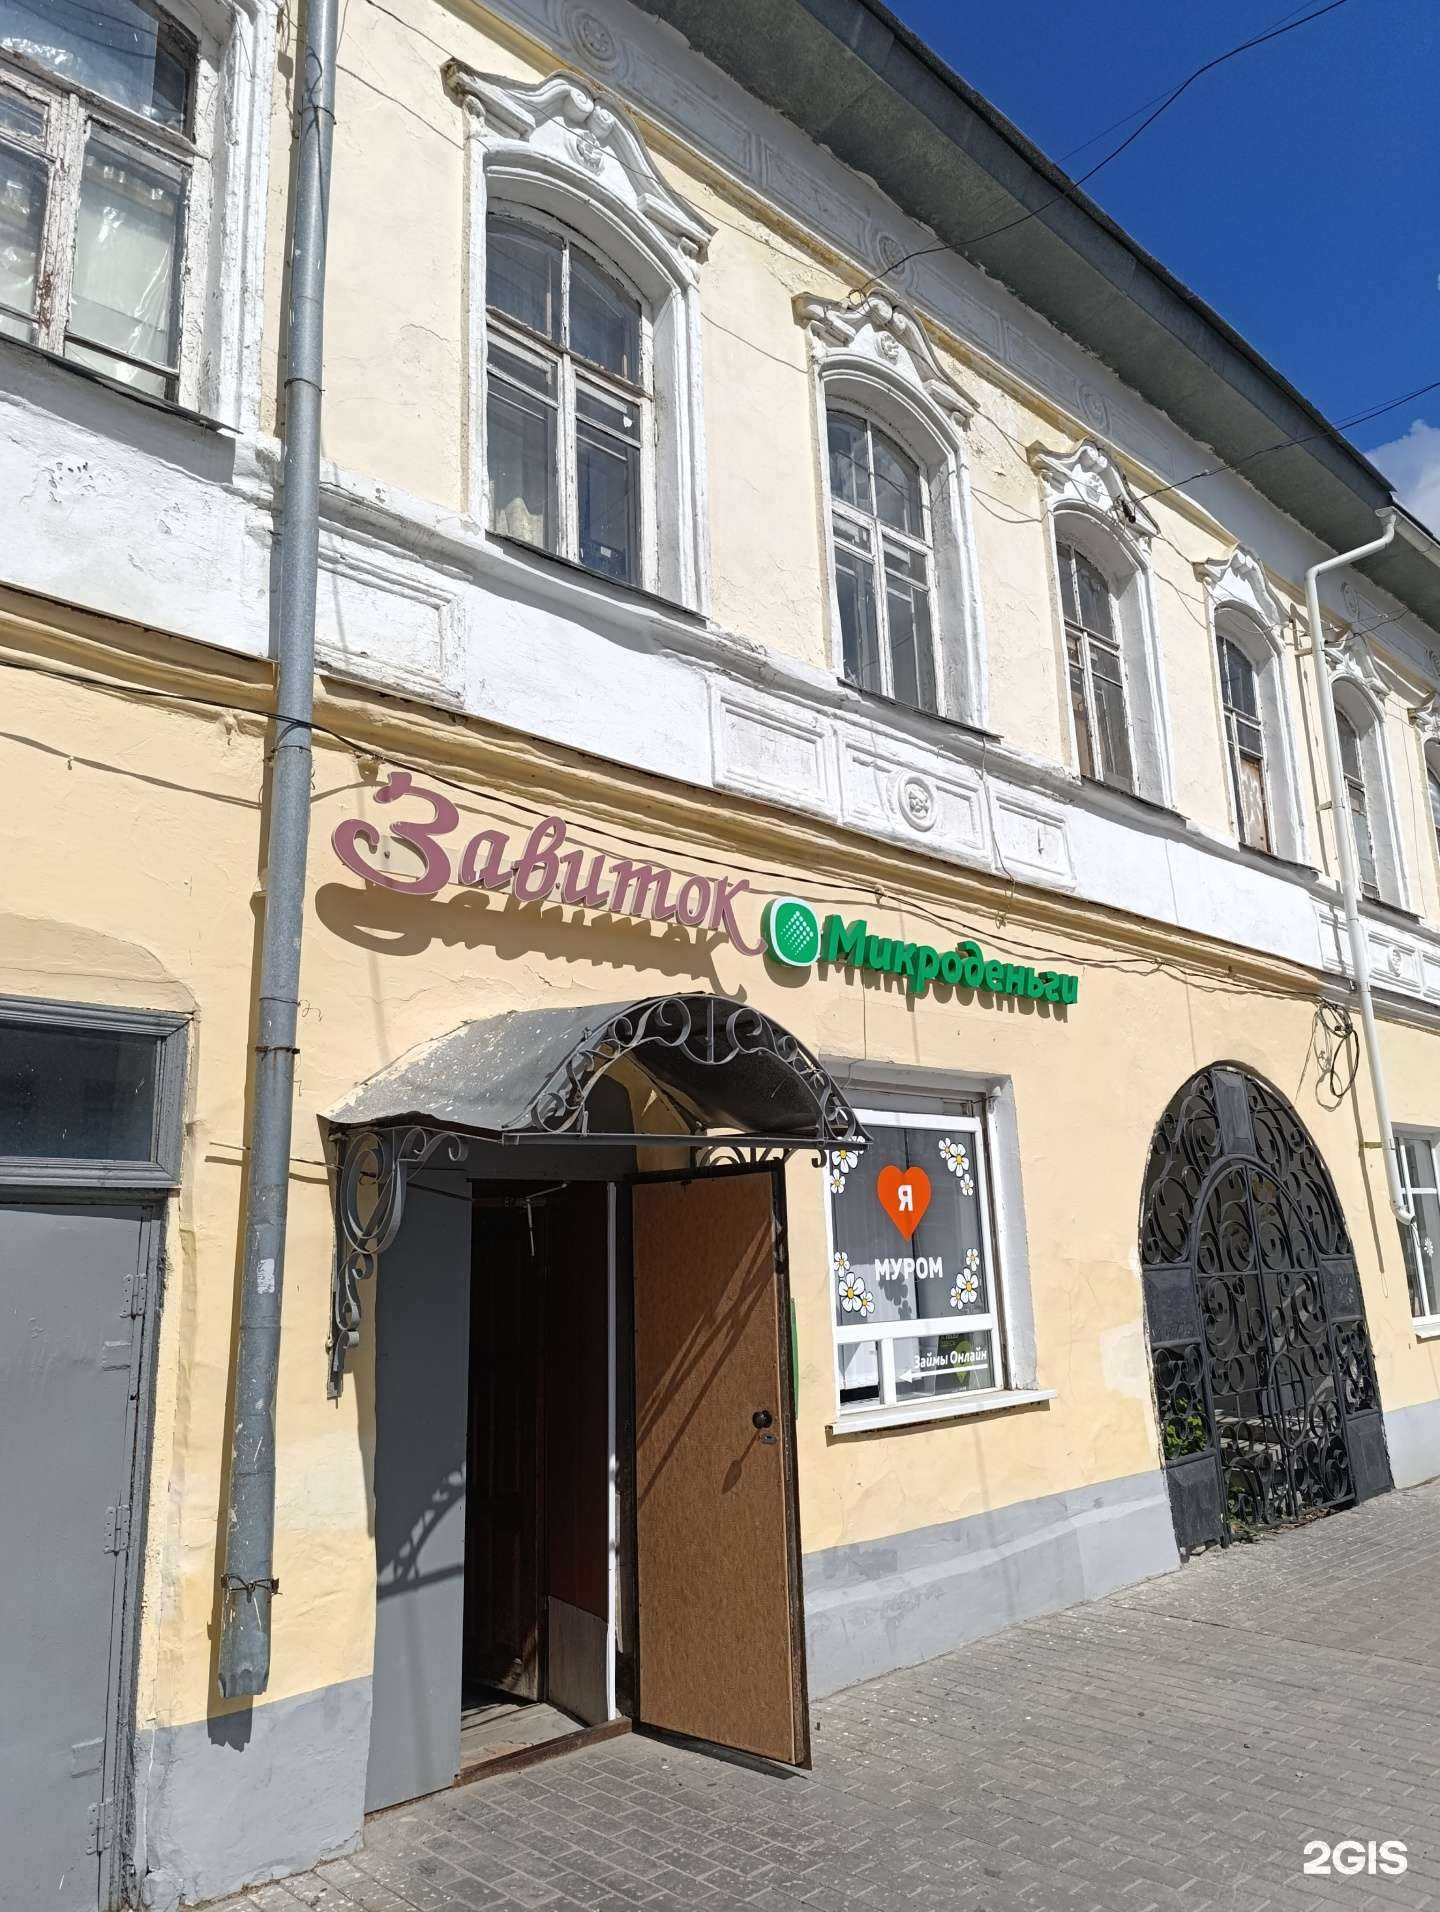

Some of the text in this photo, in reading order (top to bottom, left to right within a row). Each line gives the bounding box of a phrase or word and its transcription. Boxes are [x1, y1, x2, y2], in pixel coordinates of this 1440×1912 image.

[331, 771, 768, 957] Завиток
[822, 914, 1078, 1005] Микроденьги
[898, 1184, 914, 1212] Я
[874, 1257, 944, 1281] МУРОМ
[914, 1346, 987, 1369] Займы Онлайн
